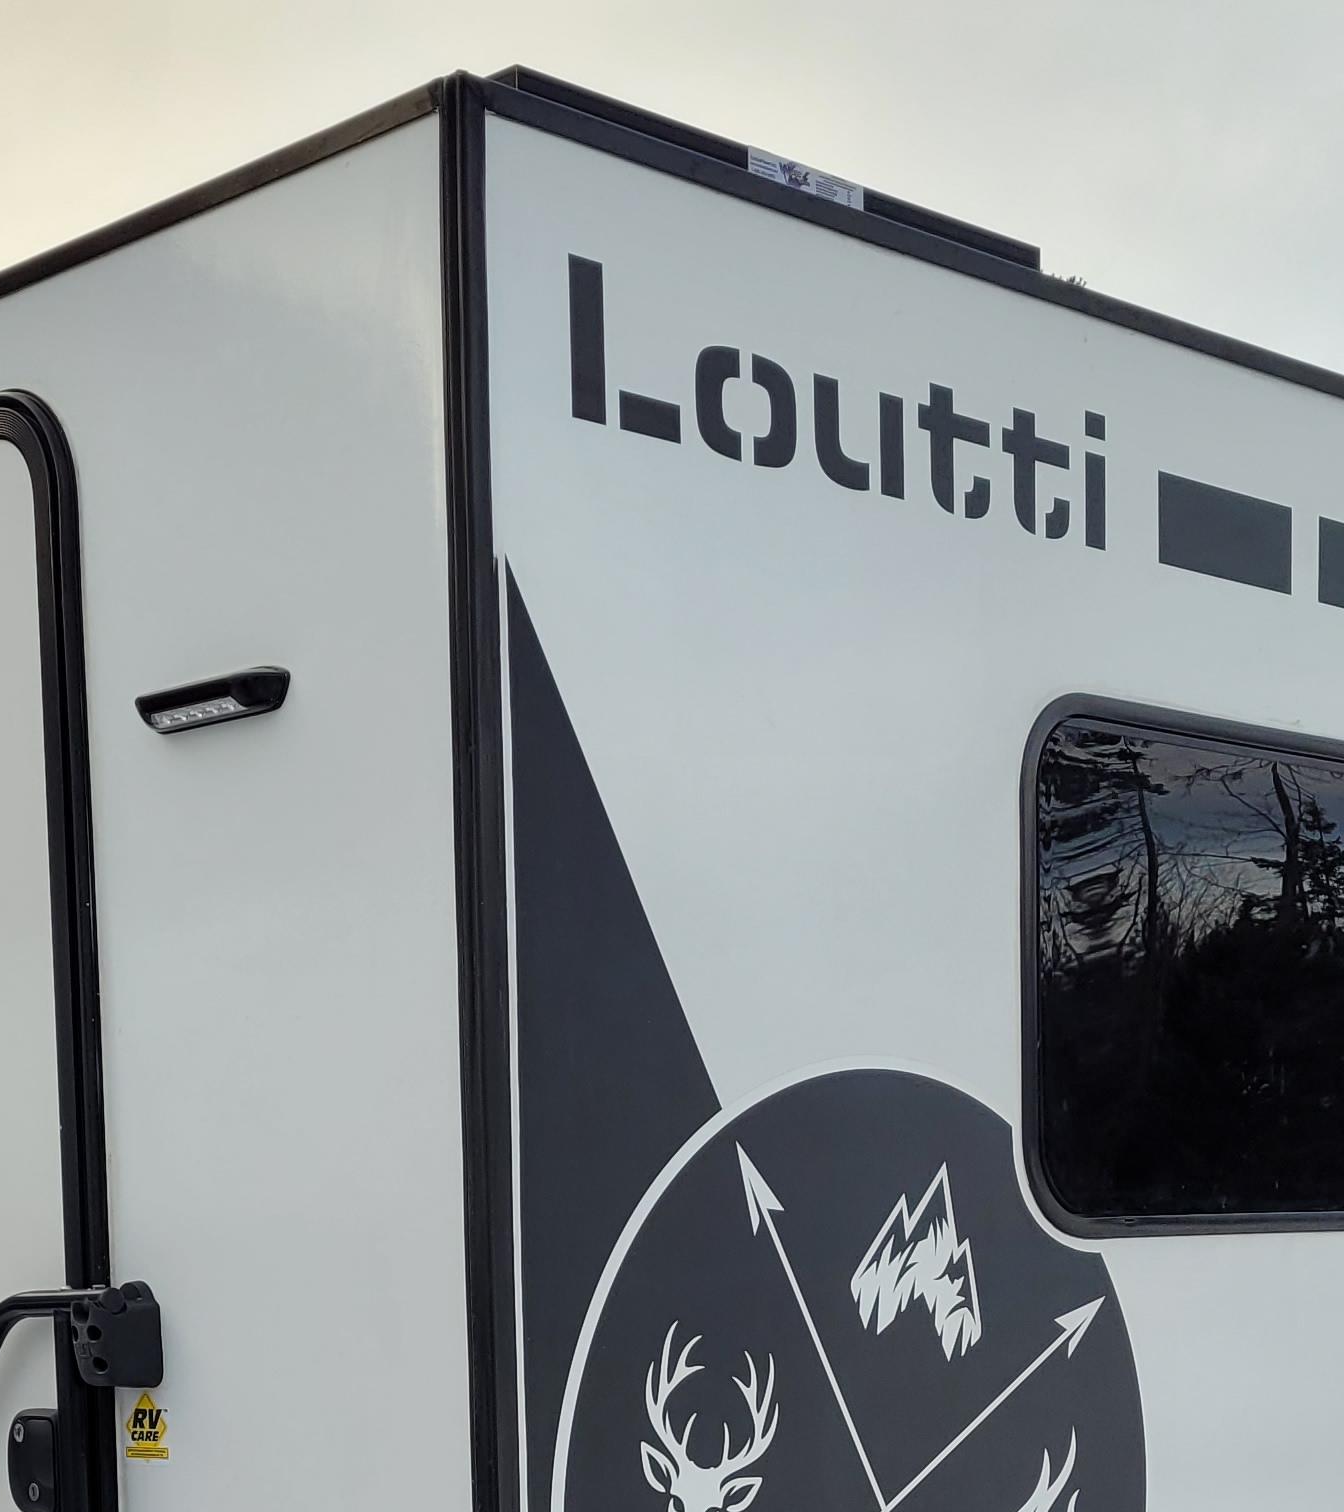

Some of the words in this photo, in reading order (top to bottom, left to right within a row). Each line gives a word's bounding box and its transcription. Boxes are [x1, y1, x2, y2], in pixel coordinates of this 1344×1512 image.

[568, 252, 1107, 551] Loutti
[132, 1407, 162, 1430] RV
[131, 1430, 160, 1442] CARE
